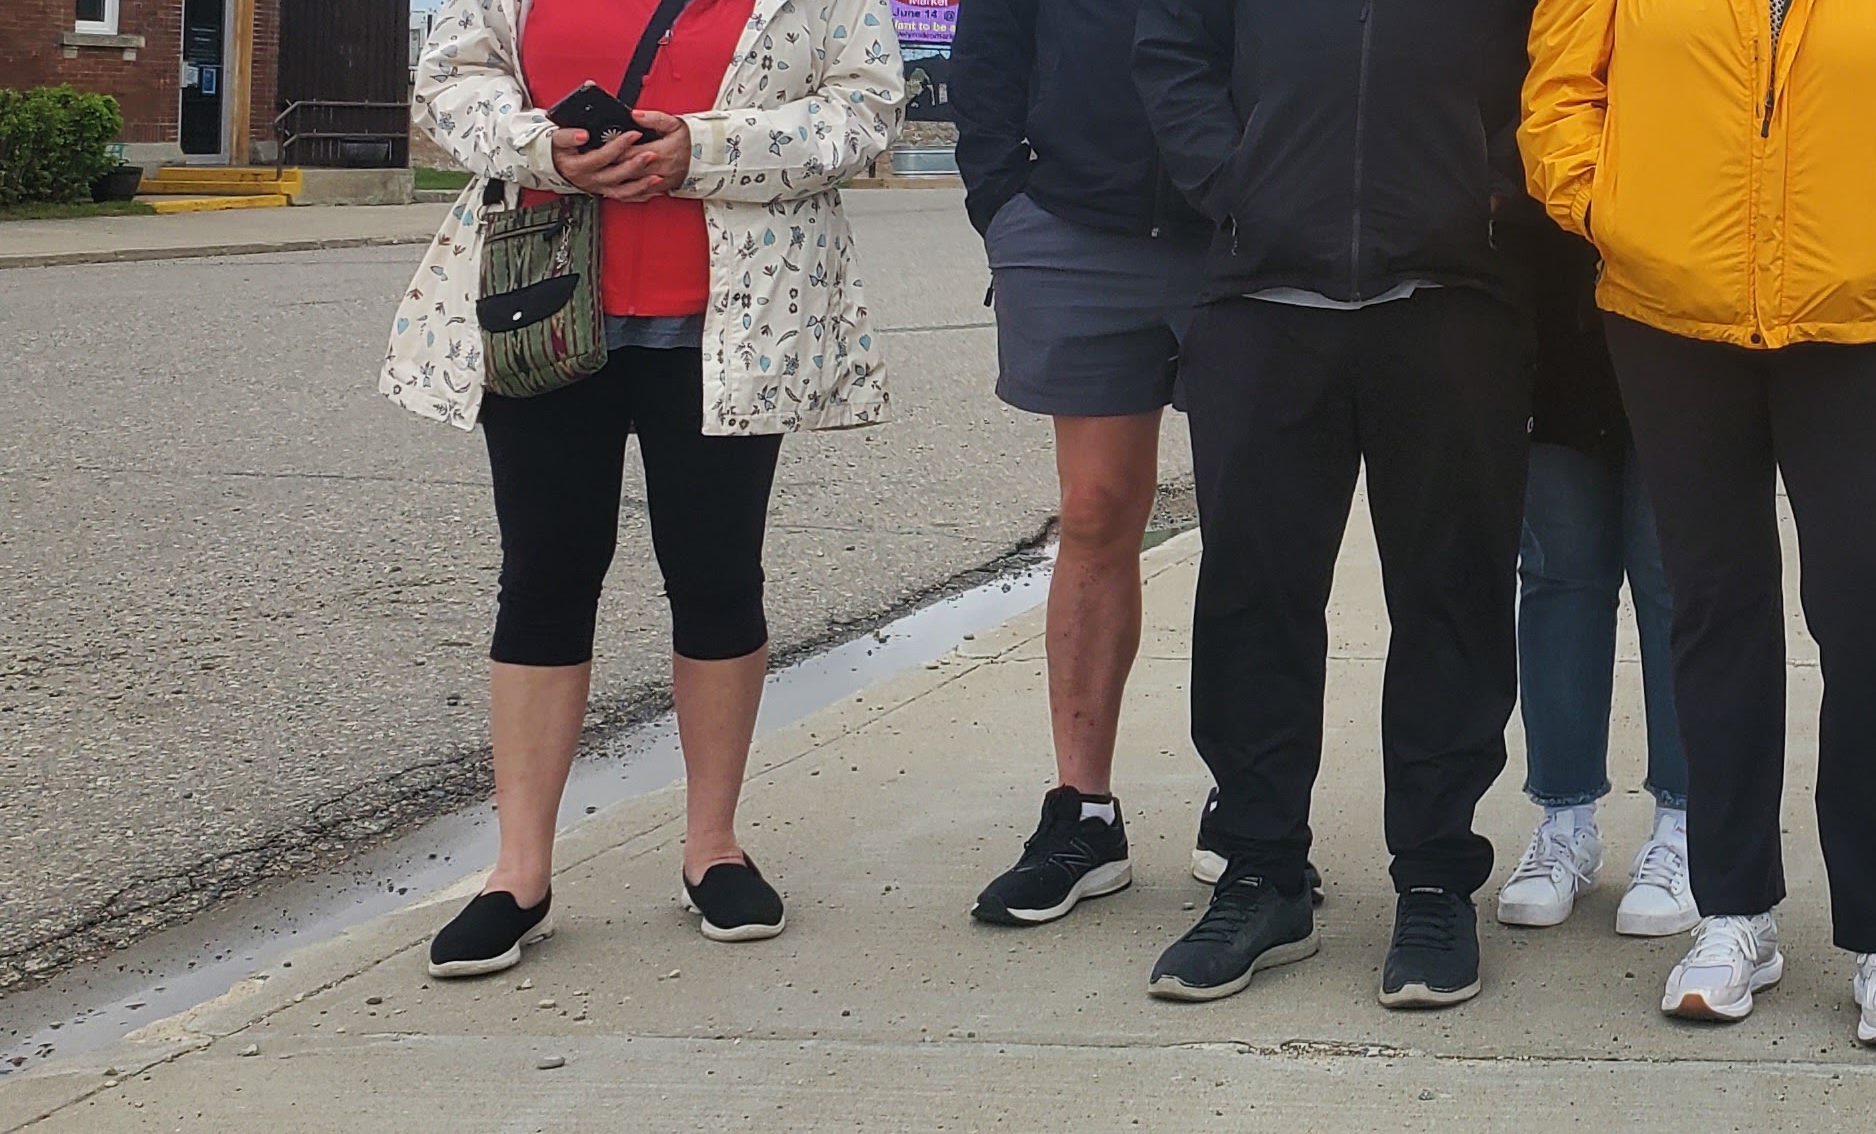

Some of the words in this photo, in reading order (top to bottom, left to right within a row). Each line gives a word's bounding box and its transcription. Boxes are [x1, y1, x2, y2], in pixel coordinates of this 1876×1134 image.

[892, 7, 921, 18] June
[924, 9, 938, 18] 14
[894, 19, 917, 31] ant
[919, 23, 930, 31] to
[933, 22, 947, 32] be
